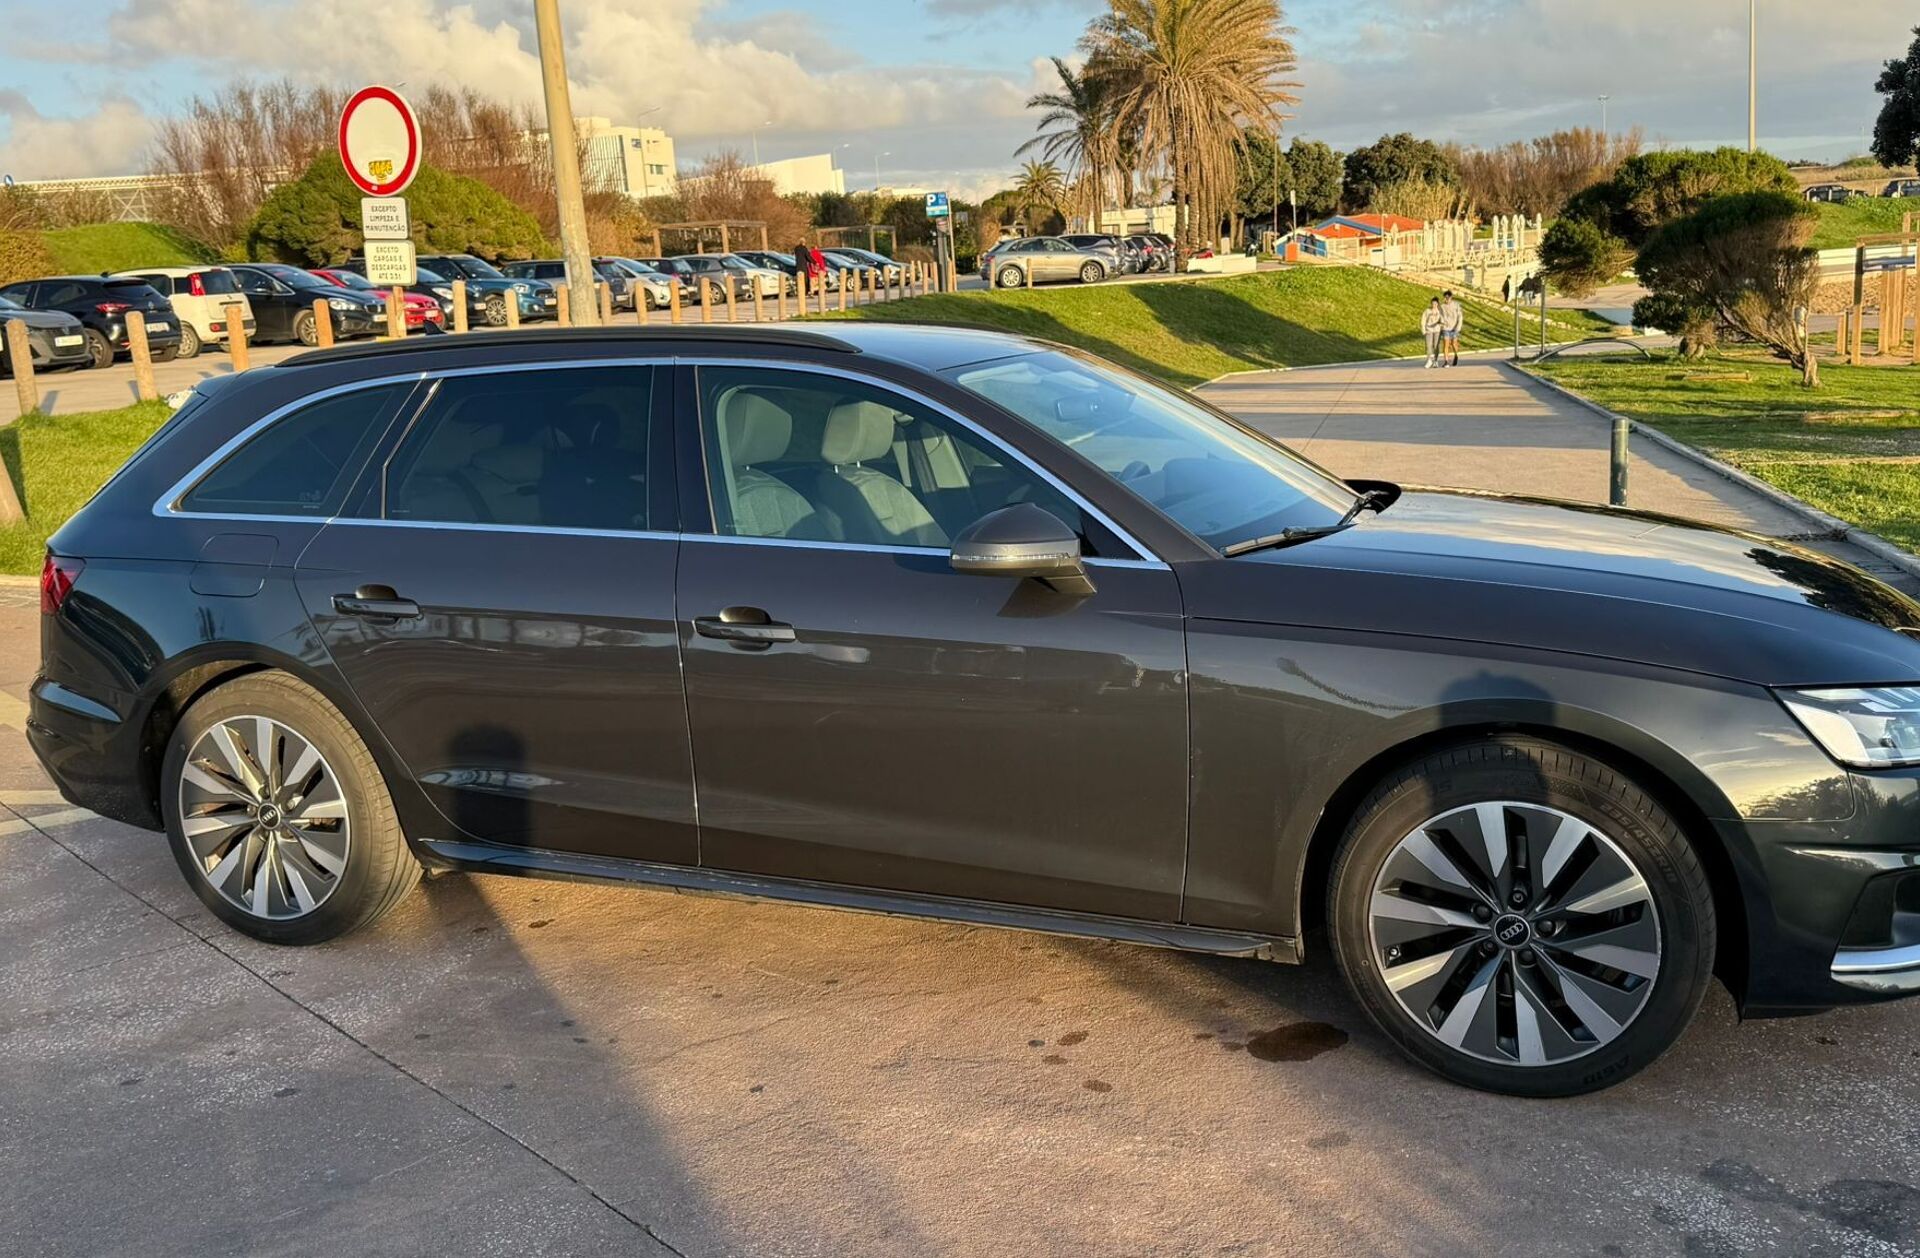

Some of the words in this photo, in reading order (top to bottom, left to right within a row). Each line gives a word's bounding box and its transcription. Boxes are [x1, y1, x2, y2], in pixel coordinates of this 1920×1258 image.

[927, 194, 936, 206] P
[365, 223, 405, 232] MANUTENÇÃO
[371, 263, 407, 271] DESCARGAS
